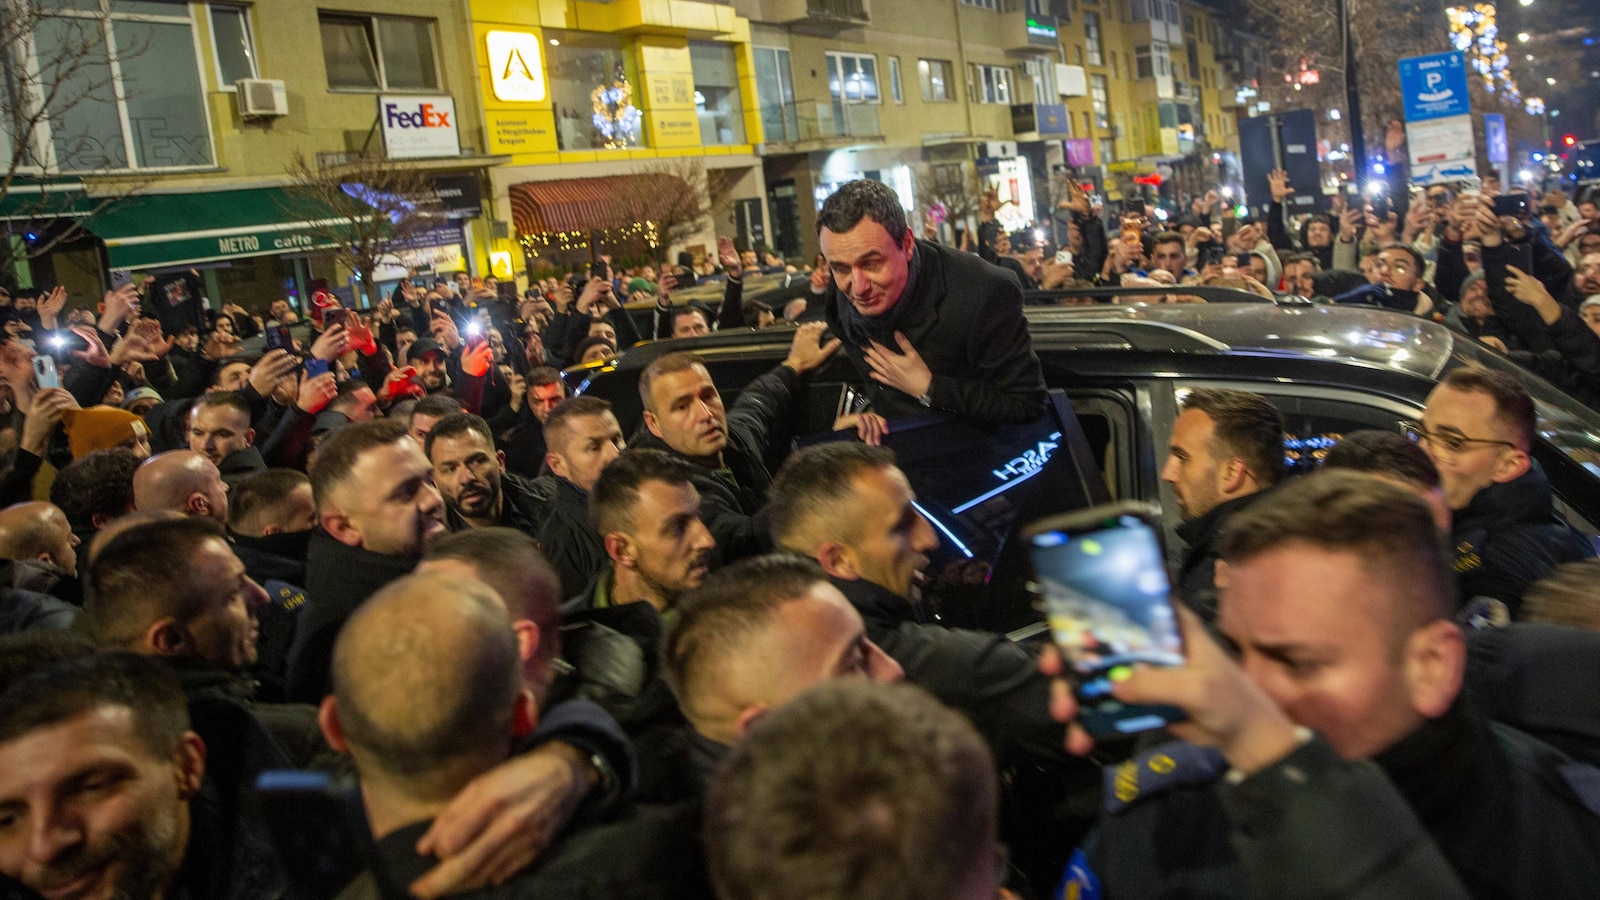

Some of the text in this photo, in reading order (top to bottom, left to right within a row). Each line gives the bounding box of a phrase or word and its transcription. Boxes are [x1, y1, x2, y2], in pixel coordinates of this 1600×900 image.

[1427, 72, 1442, 89] P
[386, 104, 452, 129] FedEx
[219, 235, 260, 254] METRO
